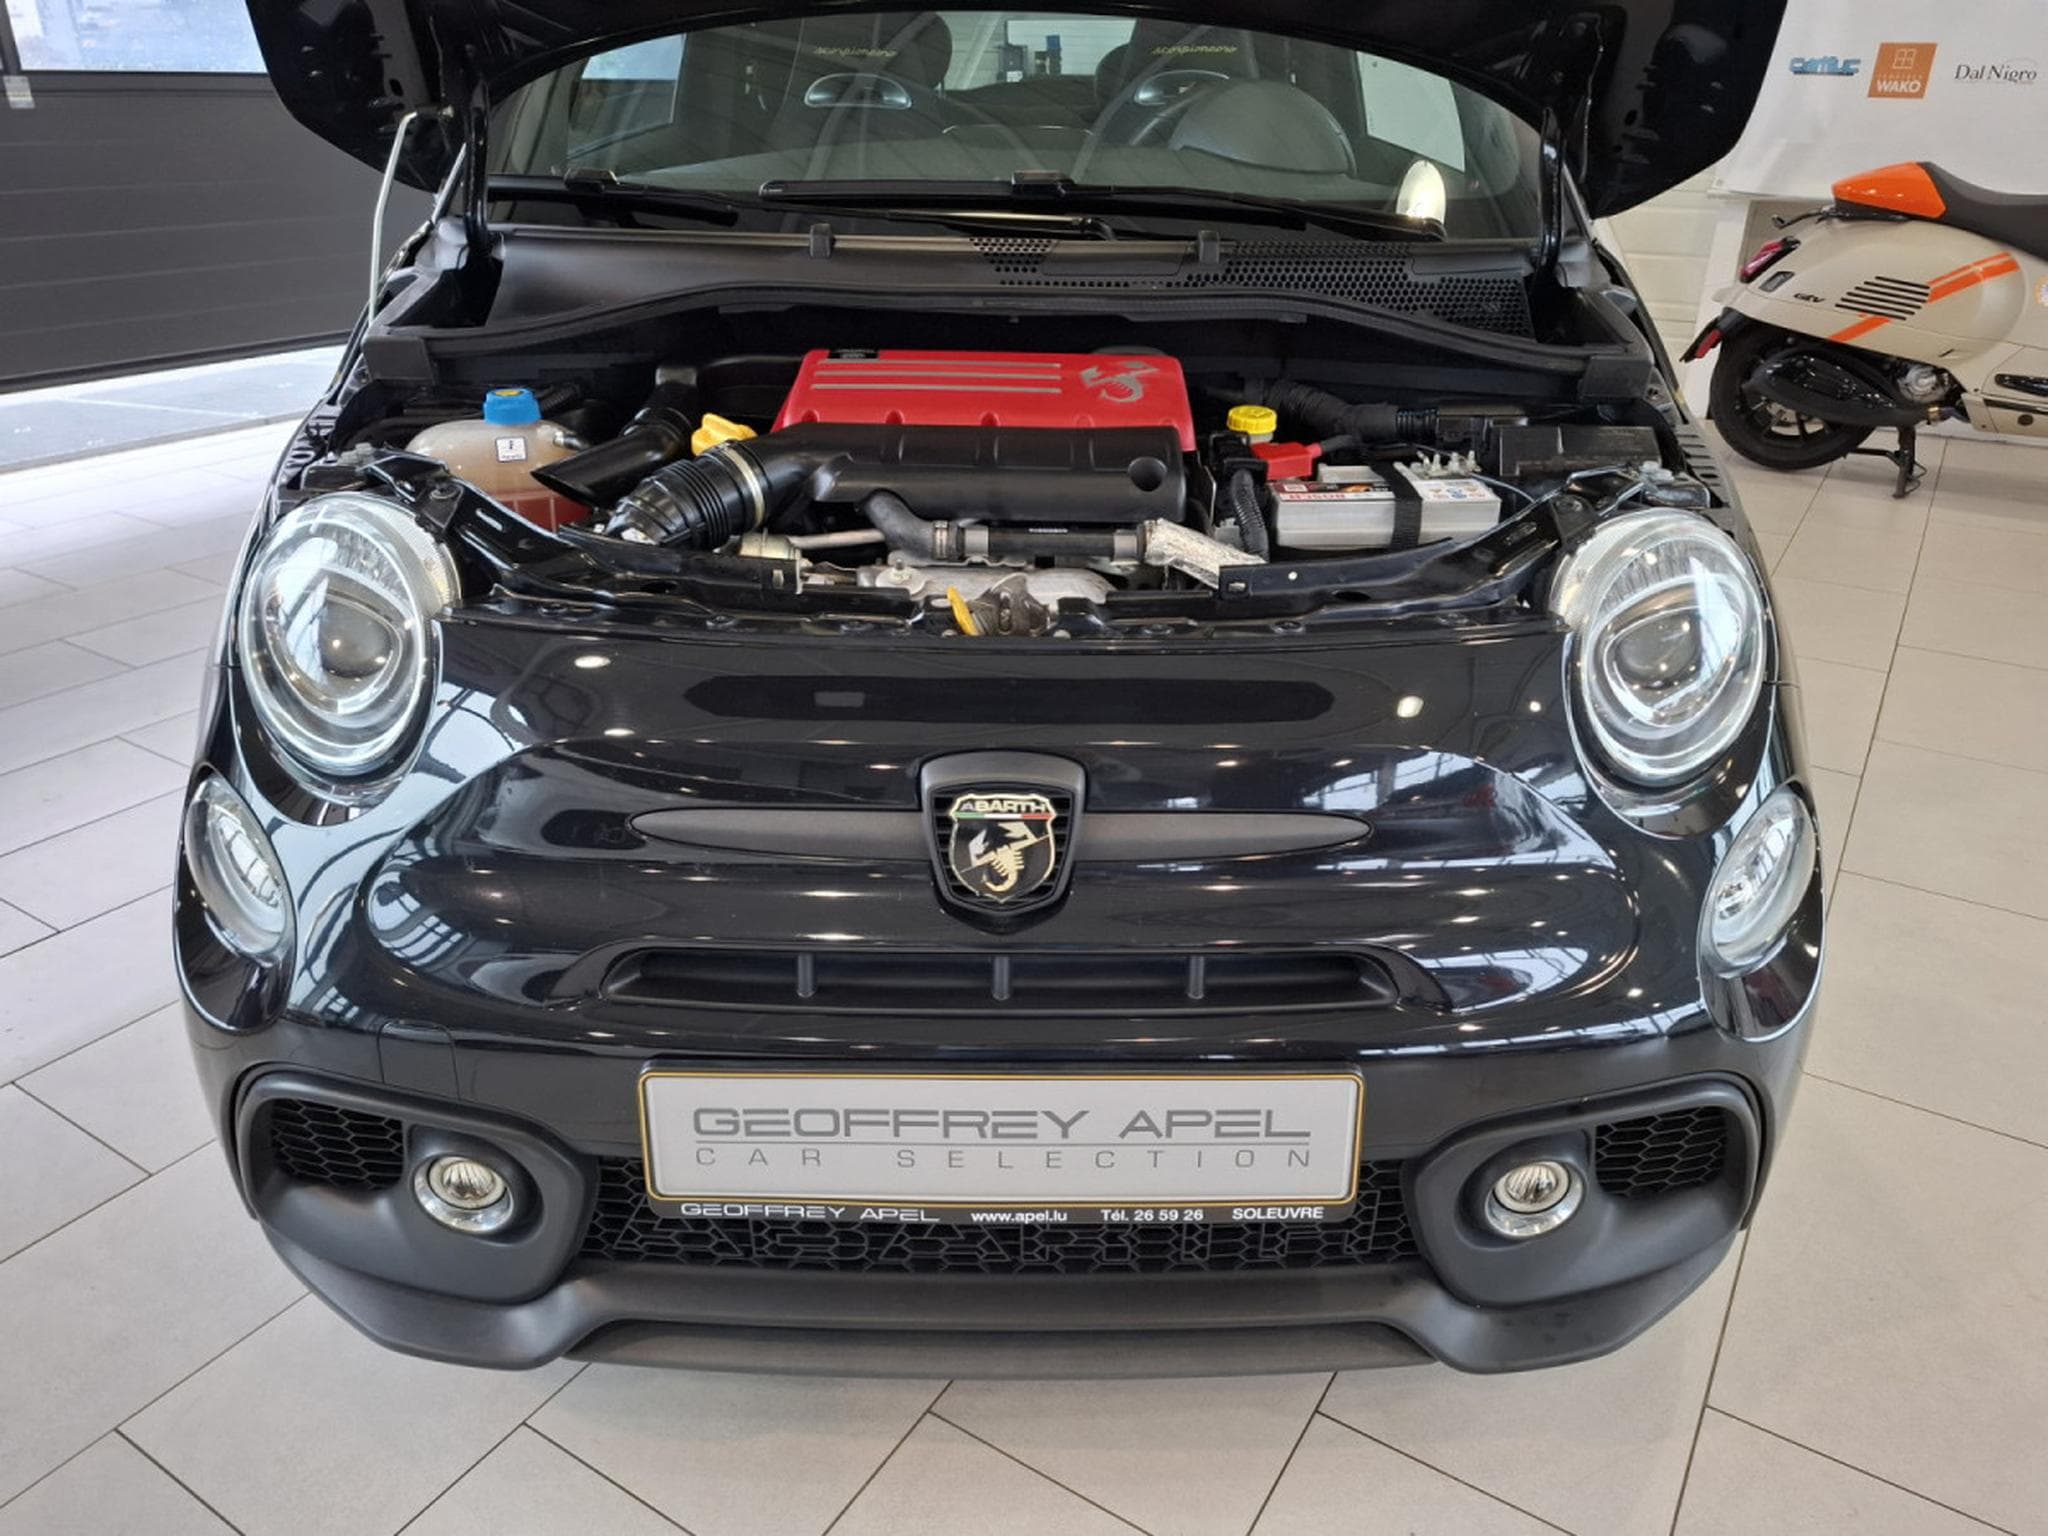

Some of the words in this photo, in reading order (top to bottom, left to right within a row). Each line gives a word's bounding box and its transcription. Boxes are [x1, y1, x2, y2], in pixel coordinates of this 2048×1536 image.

[1954, 63, 1986, 80] Dal
[1987, 63, 2038, 83] Nigro
[1876, 79, 1922, 94] WAKO
[959, 799, 1046, 813] ABARTH
[693, 1107, 1090, 1139] GEOFFREY
[1117, 1108, 1312, 1139] APEL
[695, 1147, 821, 1167] CAR
[896, 1149, 1310, 1169] SELECTION
[681, 1203, 846, 1220] GEOFFREY
[859, 1207, 941, 1222] APEL
[970, 1208, 1068, 1224] www.apel.lu
[1100, 1207, 1129, 1222] Tél.
[1134, 1208, 1154, 1222] 26
[1158, 1208, 1179, 1222] 59
[1183, 1208, 1204, 1221] 26
[1231, 1206, 1325, 1220] SOLEUVRE
